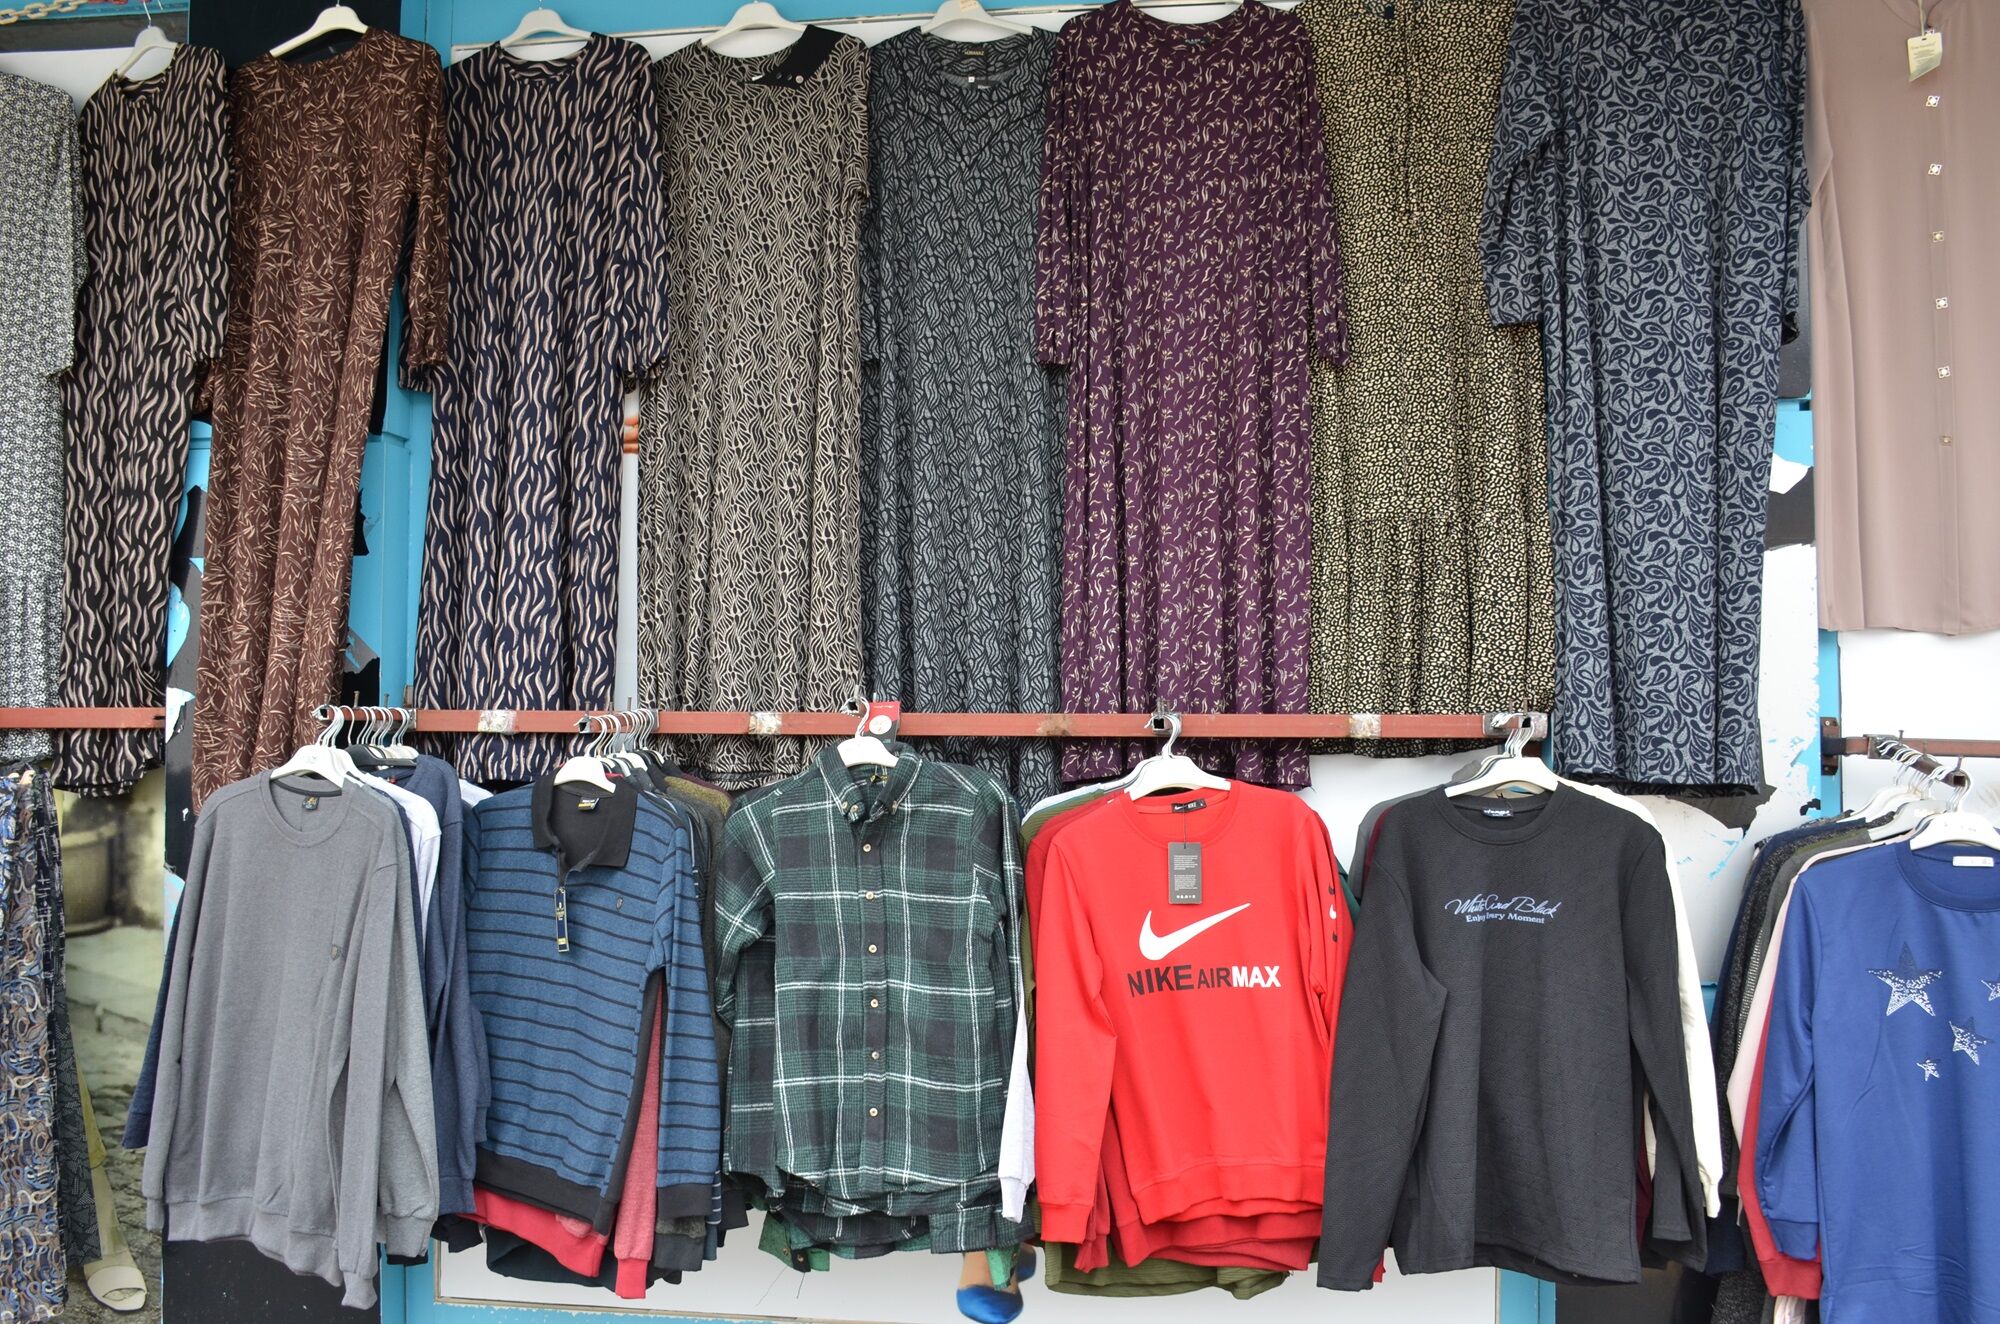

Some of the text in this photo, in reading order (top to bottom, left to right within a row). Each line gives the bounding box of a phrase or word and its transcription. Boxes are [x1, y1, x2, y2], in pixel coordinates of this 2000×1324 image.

[1507, 912, 1545, 924] Moment
[1511, 896, 1562, 918] Black
[1127, 964, 1195, 998] NIKE
